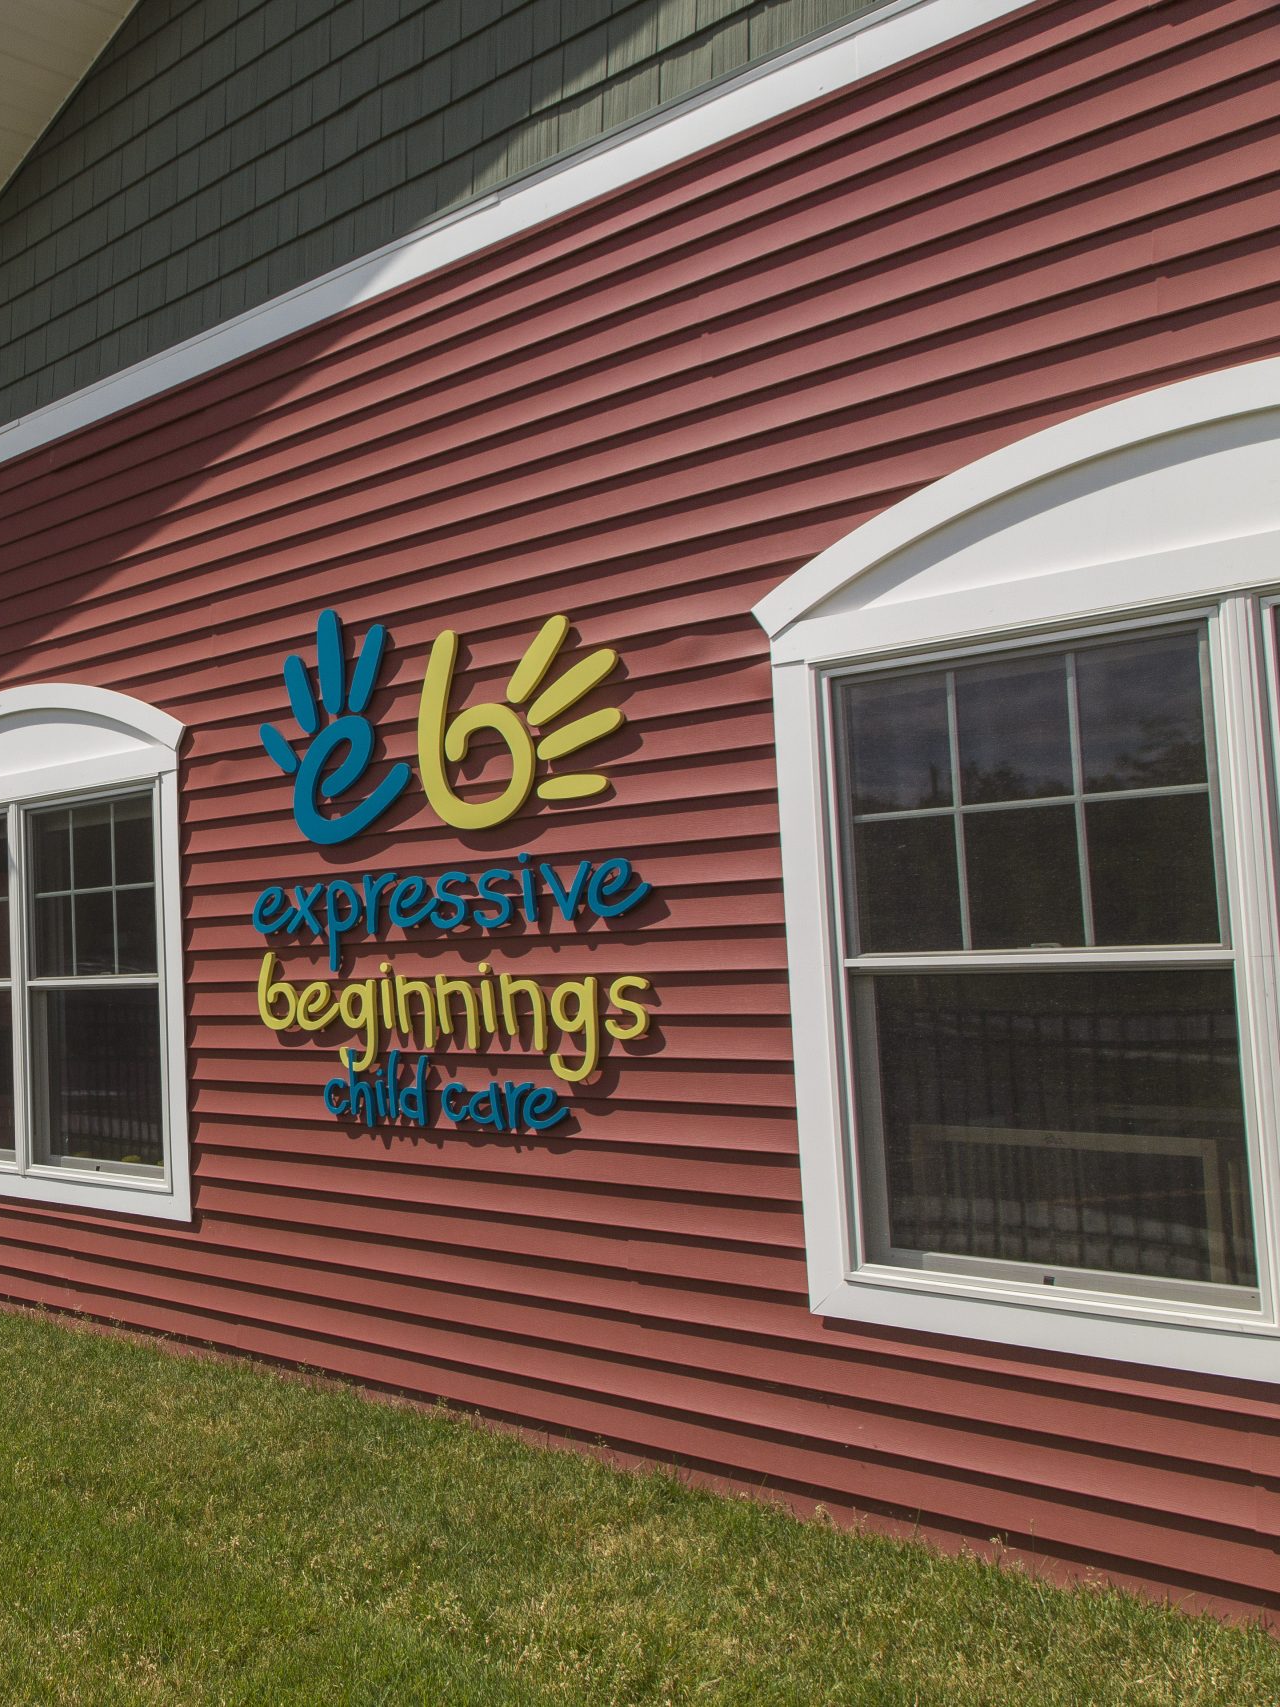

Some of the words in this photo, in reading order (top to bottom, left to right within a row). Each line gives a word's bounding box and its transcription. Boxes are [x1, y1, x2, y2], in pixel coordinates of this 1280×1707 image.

[252, 852, 652, 972] expressive
[257, 951, 650, 1083] beginnings
[324, 1049, 429, 1127] child
[440, 1081, 571, 1131] care
